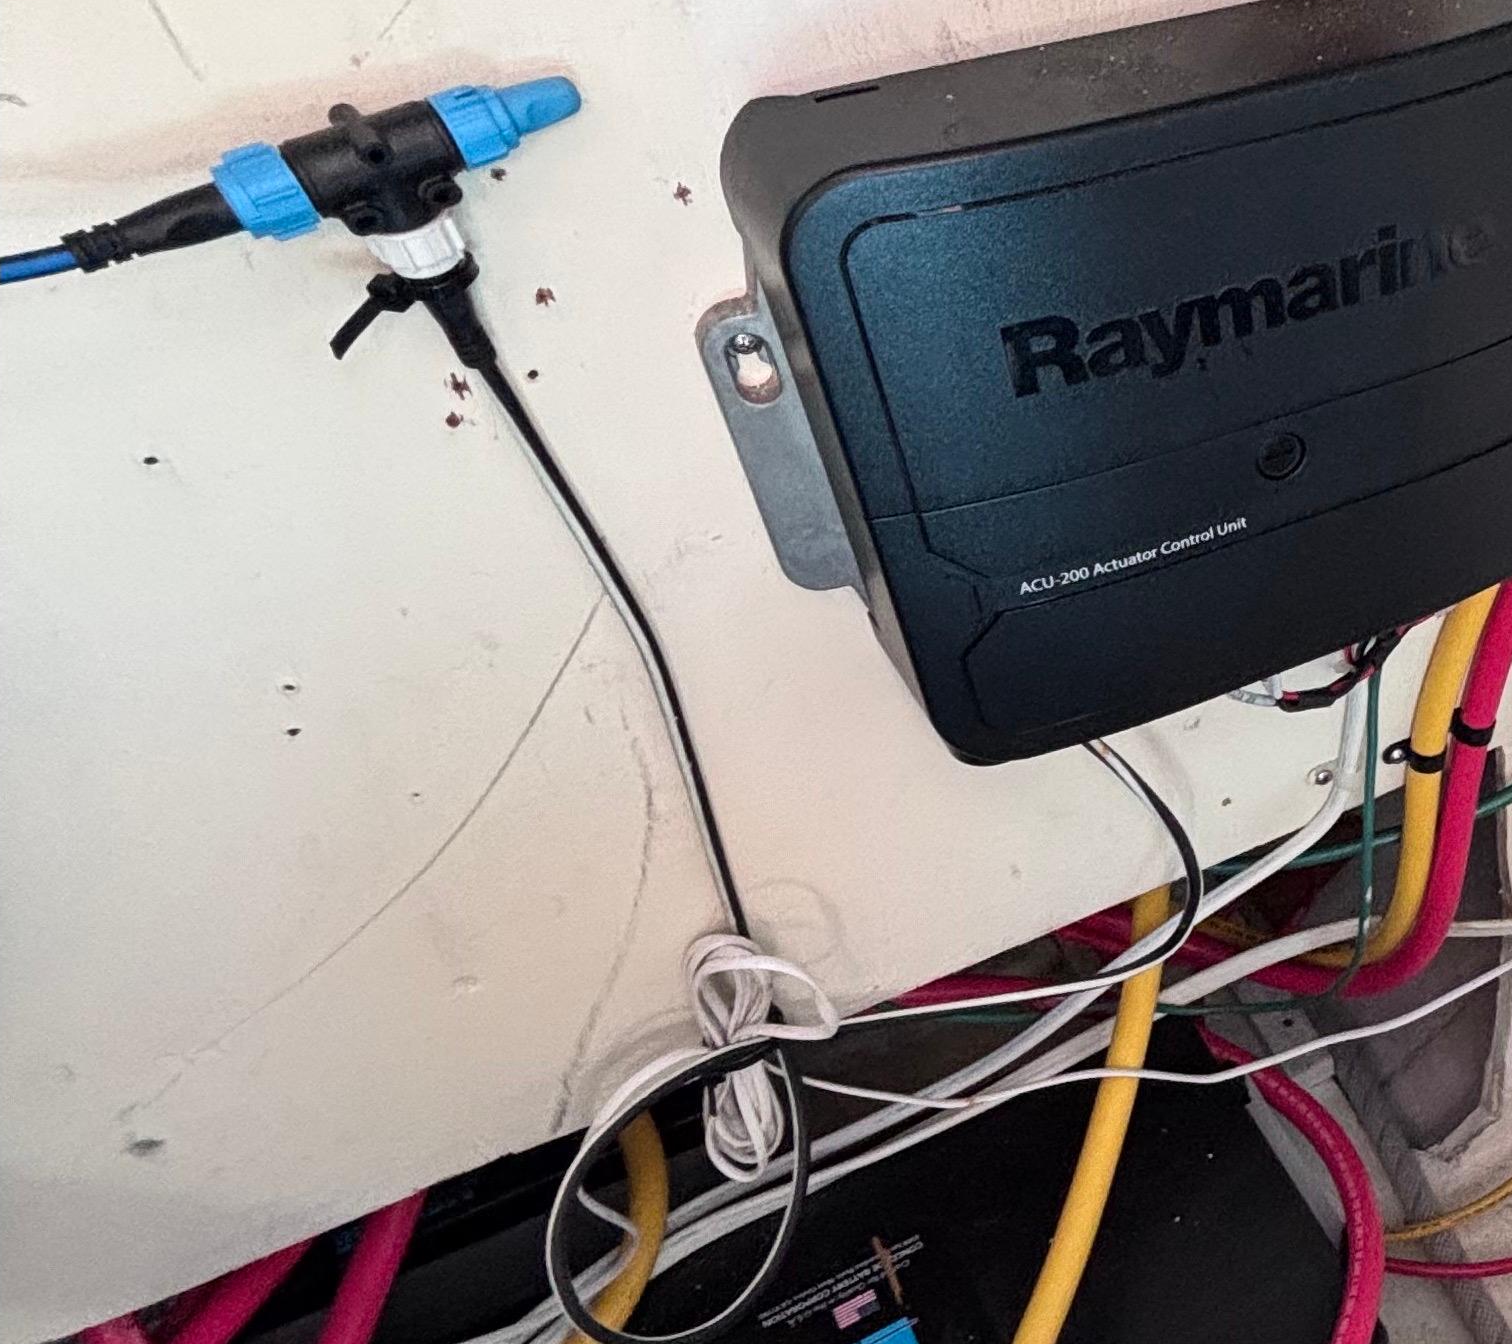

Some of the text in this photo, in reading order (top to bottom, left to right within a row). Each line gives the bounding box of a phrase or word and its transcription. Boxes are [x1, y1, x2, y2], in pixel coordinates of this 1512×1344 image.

[1019, 516, 1247, 596] ACU-200 Actuator Control Unit
